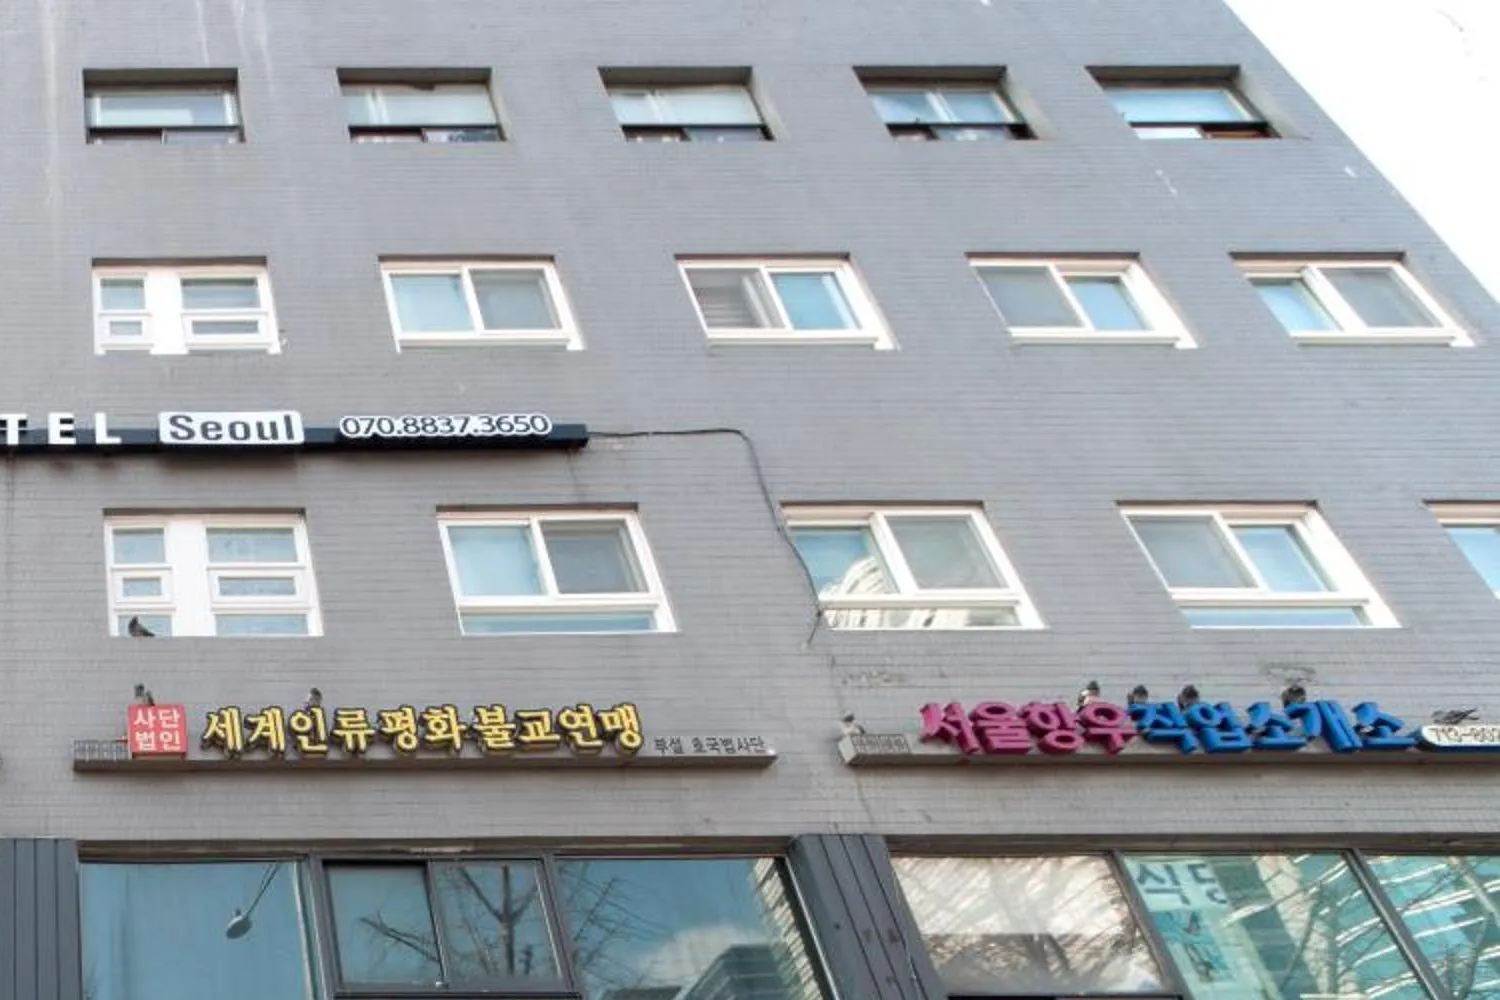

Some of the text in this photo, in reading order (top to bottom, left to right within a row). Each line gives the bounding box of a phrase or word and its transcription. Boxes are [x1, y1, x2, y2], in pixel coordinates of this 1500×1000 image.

[167, 414, 297, 442] Seoul
[340, 415, 551, 437] 070.8837.3650
[133, 707, 181, 728] 사단
[135, 731, 182, 752] 법인
